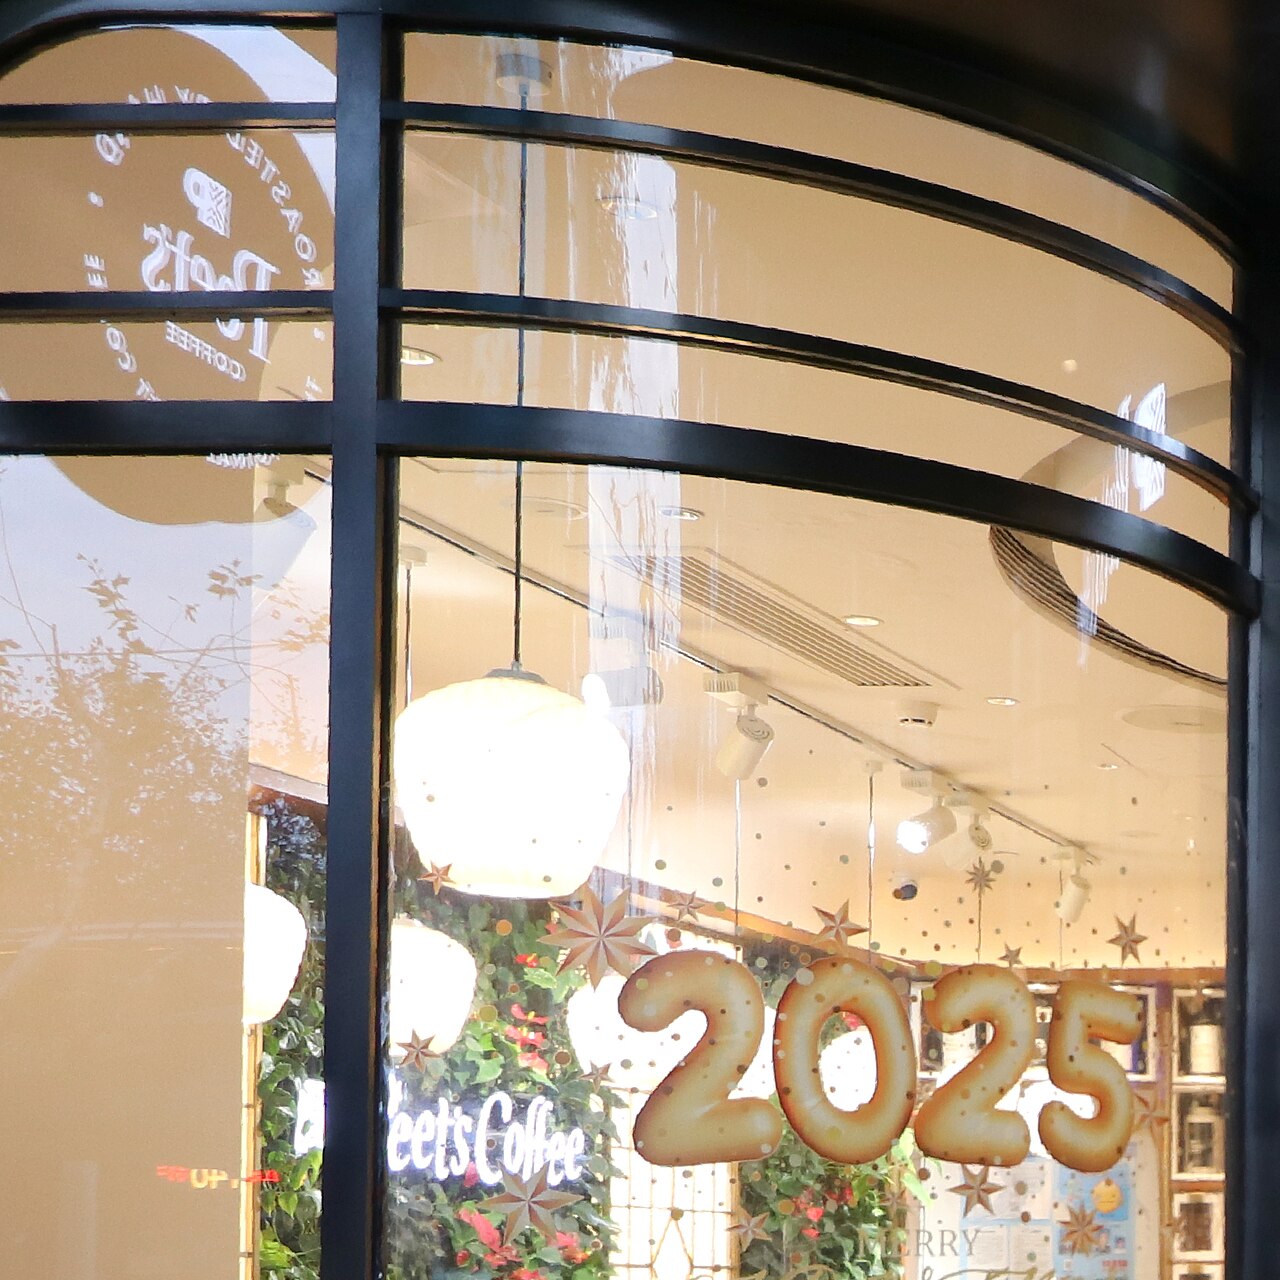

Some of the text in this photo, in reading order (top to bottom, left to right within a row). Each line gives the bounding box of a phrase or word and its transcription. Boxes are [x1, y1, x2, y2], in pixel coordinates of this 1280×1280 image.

[617, 948, 1143, 1173] 2025
[387, 1066, 585, 1187] eet's Coffee
[858, 1226, 986, 1257] MERRY
